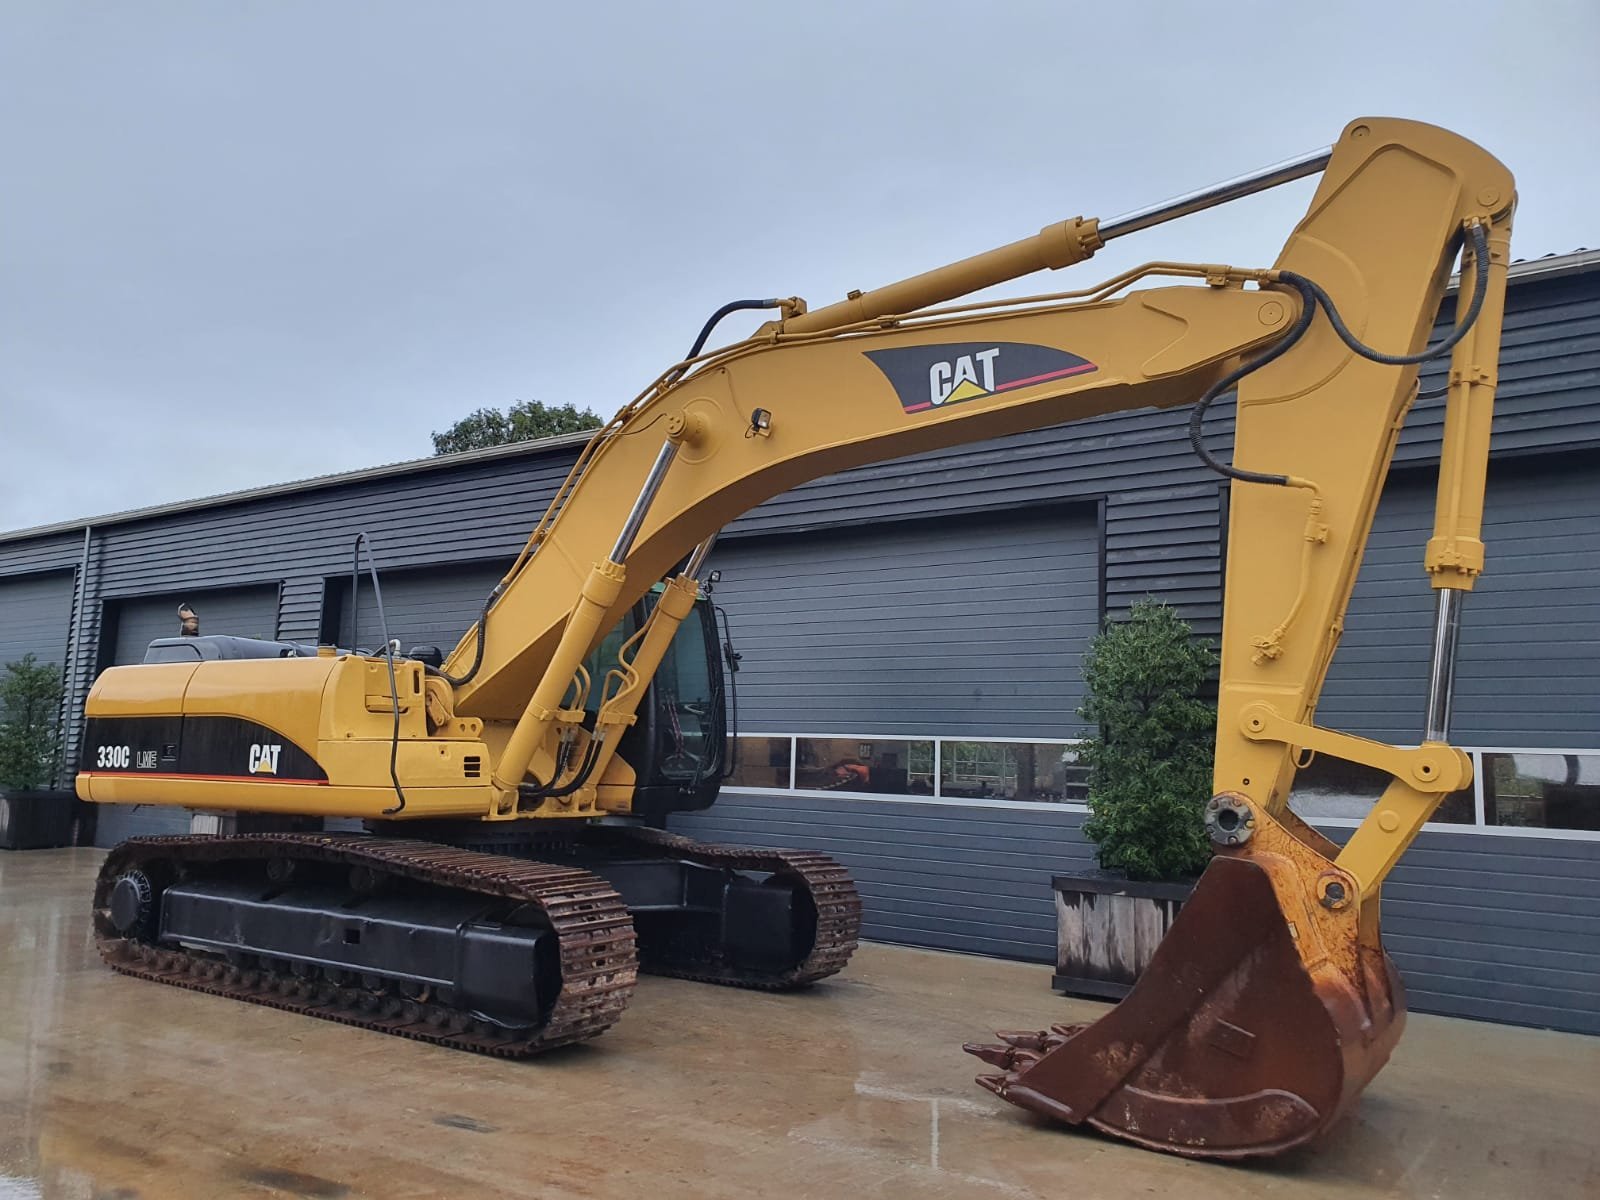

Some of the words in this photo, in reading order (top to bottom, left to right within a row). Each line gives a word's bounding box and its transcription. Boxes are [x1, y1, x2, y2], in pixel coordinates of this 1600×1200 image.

[930, 348, 1000, 405] CAT
[97, 745, 130, 769] 330C
[248, 743, 282, 775] CAT
